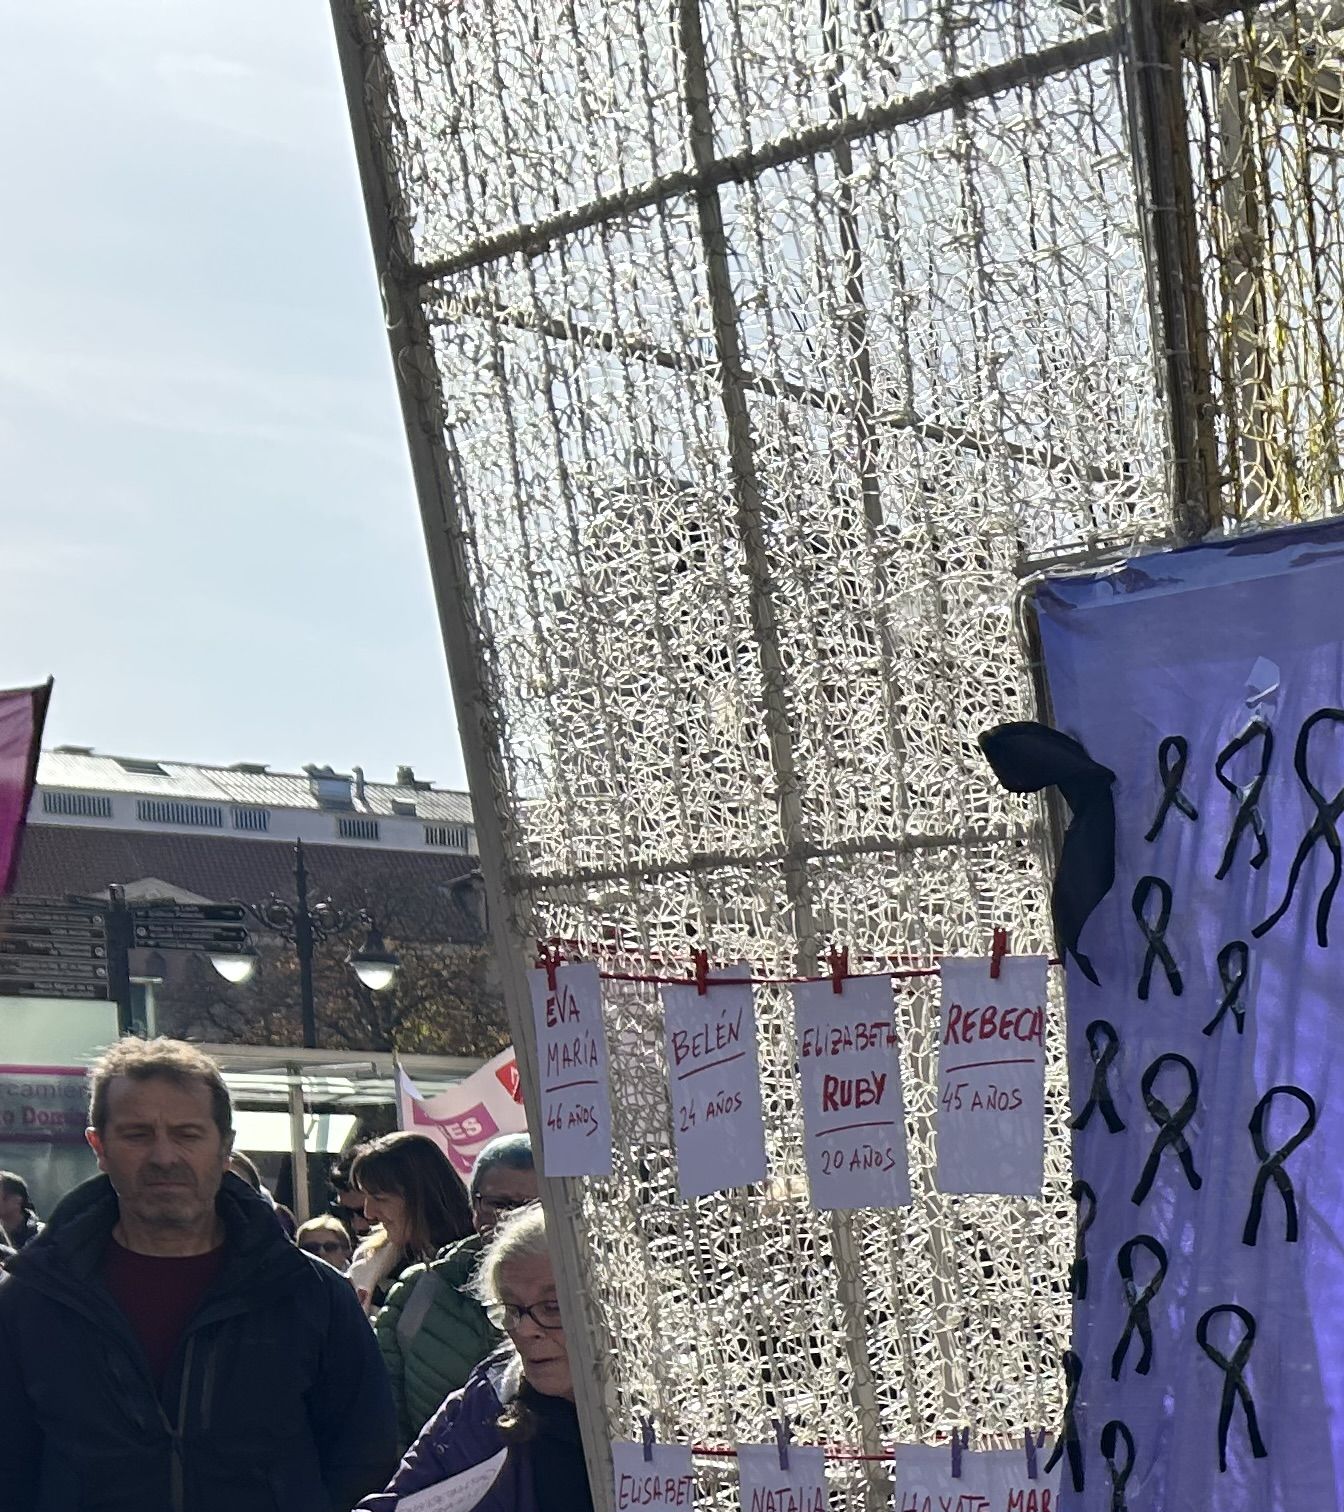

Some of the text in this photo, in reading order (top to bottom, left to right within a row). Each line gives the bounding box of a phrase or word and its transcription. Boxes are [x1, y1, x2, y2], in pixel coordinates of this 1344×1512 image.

[547, 985, 580, 1028] EVA
[944, 1003, 1045, 1047] REBECA
[547, 1029, 599, 1077] MARÍA
[672, 1008, 743, 1065] BELÉN
[802, 1022, 897, 1057] ELIZABETH
[680, 1091, 743, 1132] 24 AÑOS
[823, 1071, 887, 1112] RUBY
[942, 1084, 1023, 1112] 45 AÑOS
[547, 1103, 598, 1136] 46 AÑOS
[822, 1145, 895, 1175] 20 AÑOS
